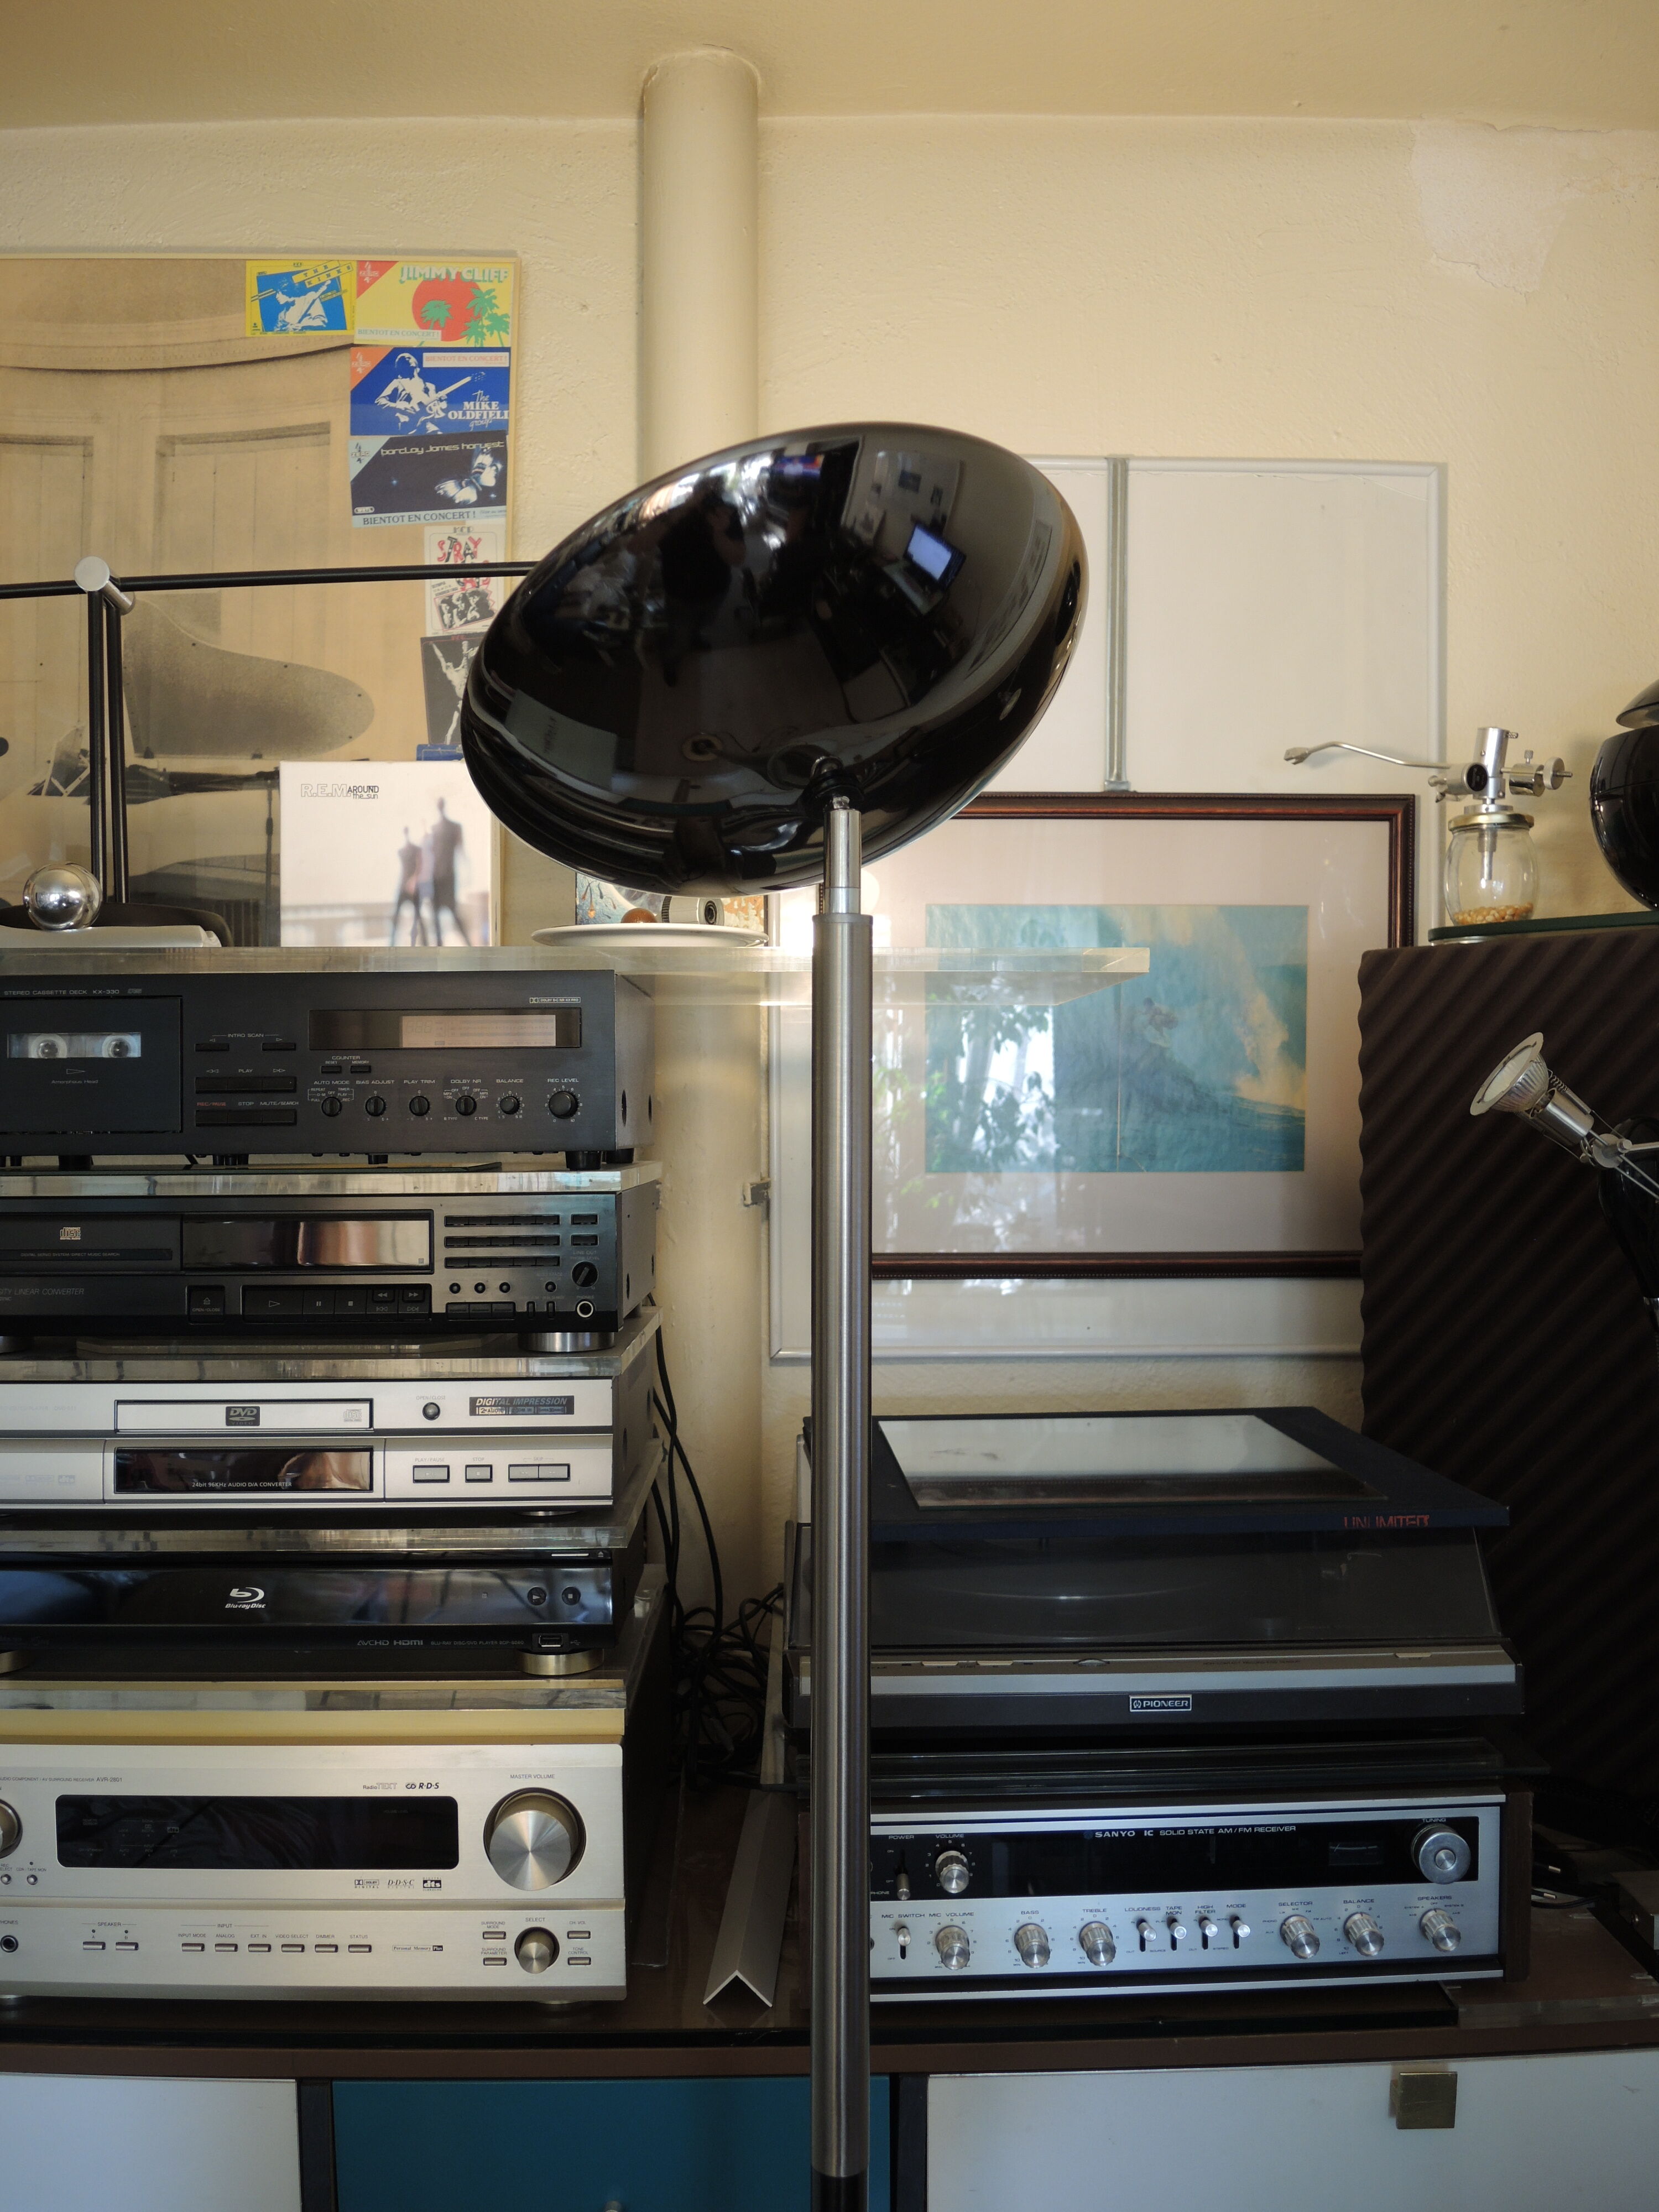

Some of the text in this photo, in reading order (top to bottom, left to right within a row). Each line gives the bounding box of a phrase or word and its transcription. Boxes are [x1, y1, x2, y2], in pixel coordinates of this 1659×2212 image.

[399, 265, 460, 284] JIMMY
[461, 267, 509, 283] CLIFF
[463, 401, 499, 410] MIKE
[363, 515, 405, 525] BIENTOT
[408, 514, 421, 523] EN
[424, 511, 470, 522] CONCERT
[437, 536, 482, 564] STRAY
[347, 785, 379, 794] AROUND
[14, 1288, 40, 1296] LINEAR
[229, 1407, 257, 1417] DVD
[1142, 1700, 1189, 1708] PIONEER
